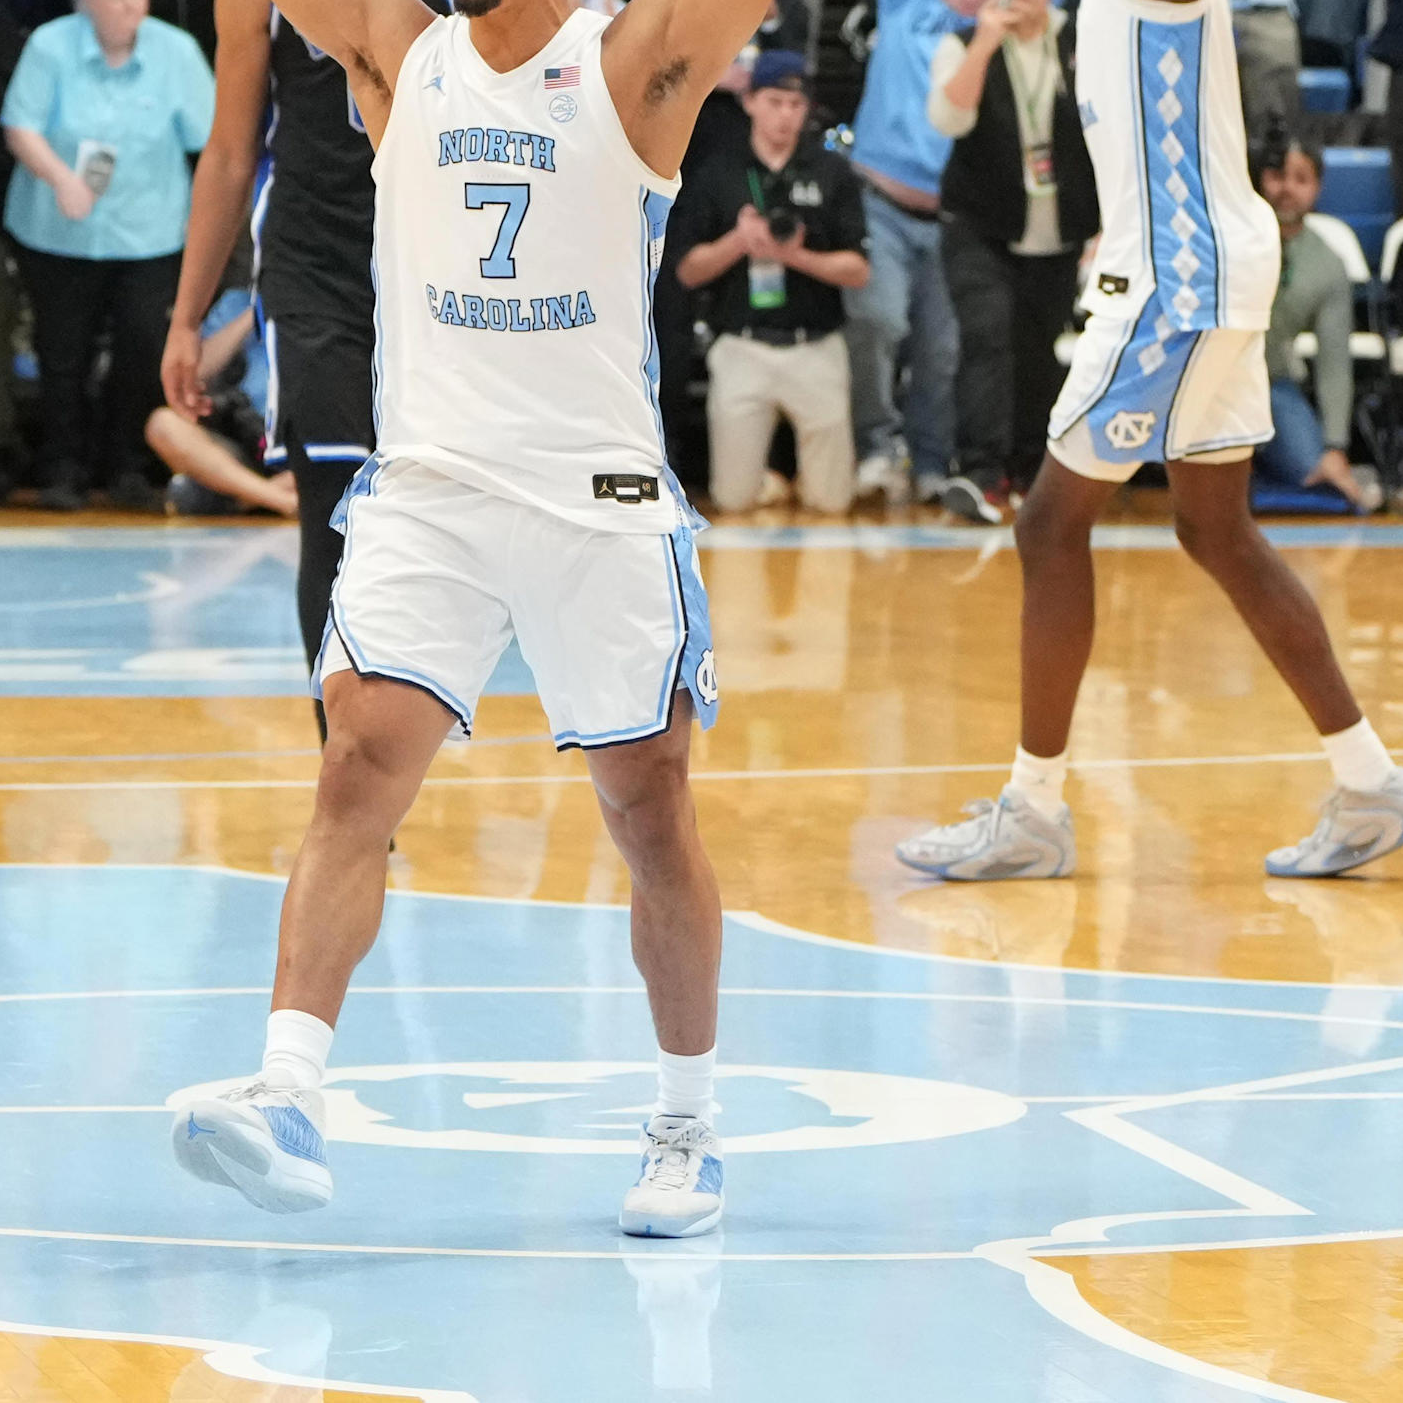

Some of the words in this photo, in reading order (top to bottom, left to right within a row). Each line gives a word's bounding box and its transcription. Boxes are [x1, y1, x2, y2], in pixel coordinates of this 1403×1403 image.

[438, 127, 556, 172] NORTH
[464, 182, 530, 278] 7
[425, 283, 596, 332] CAROLINA
